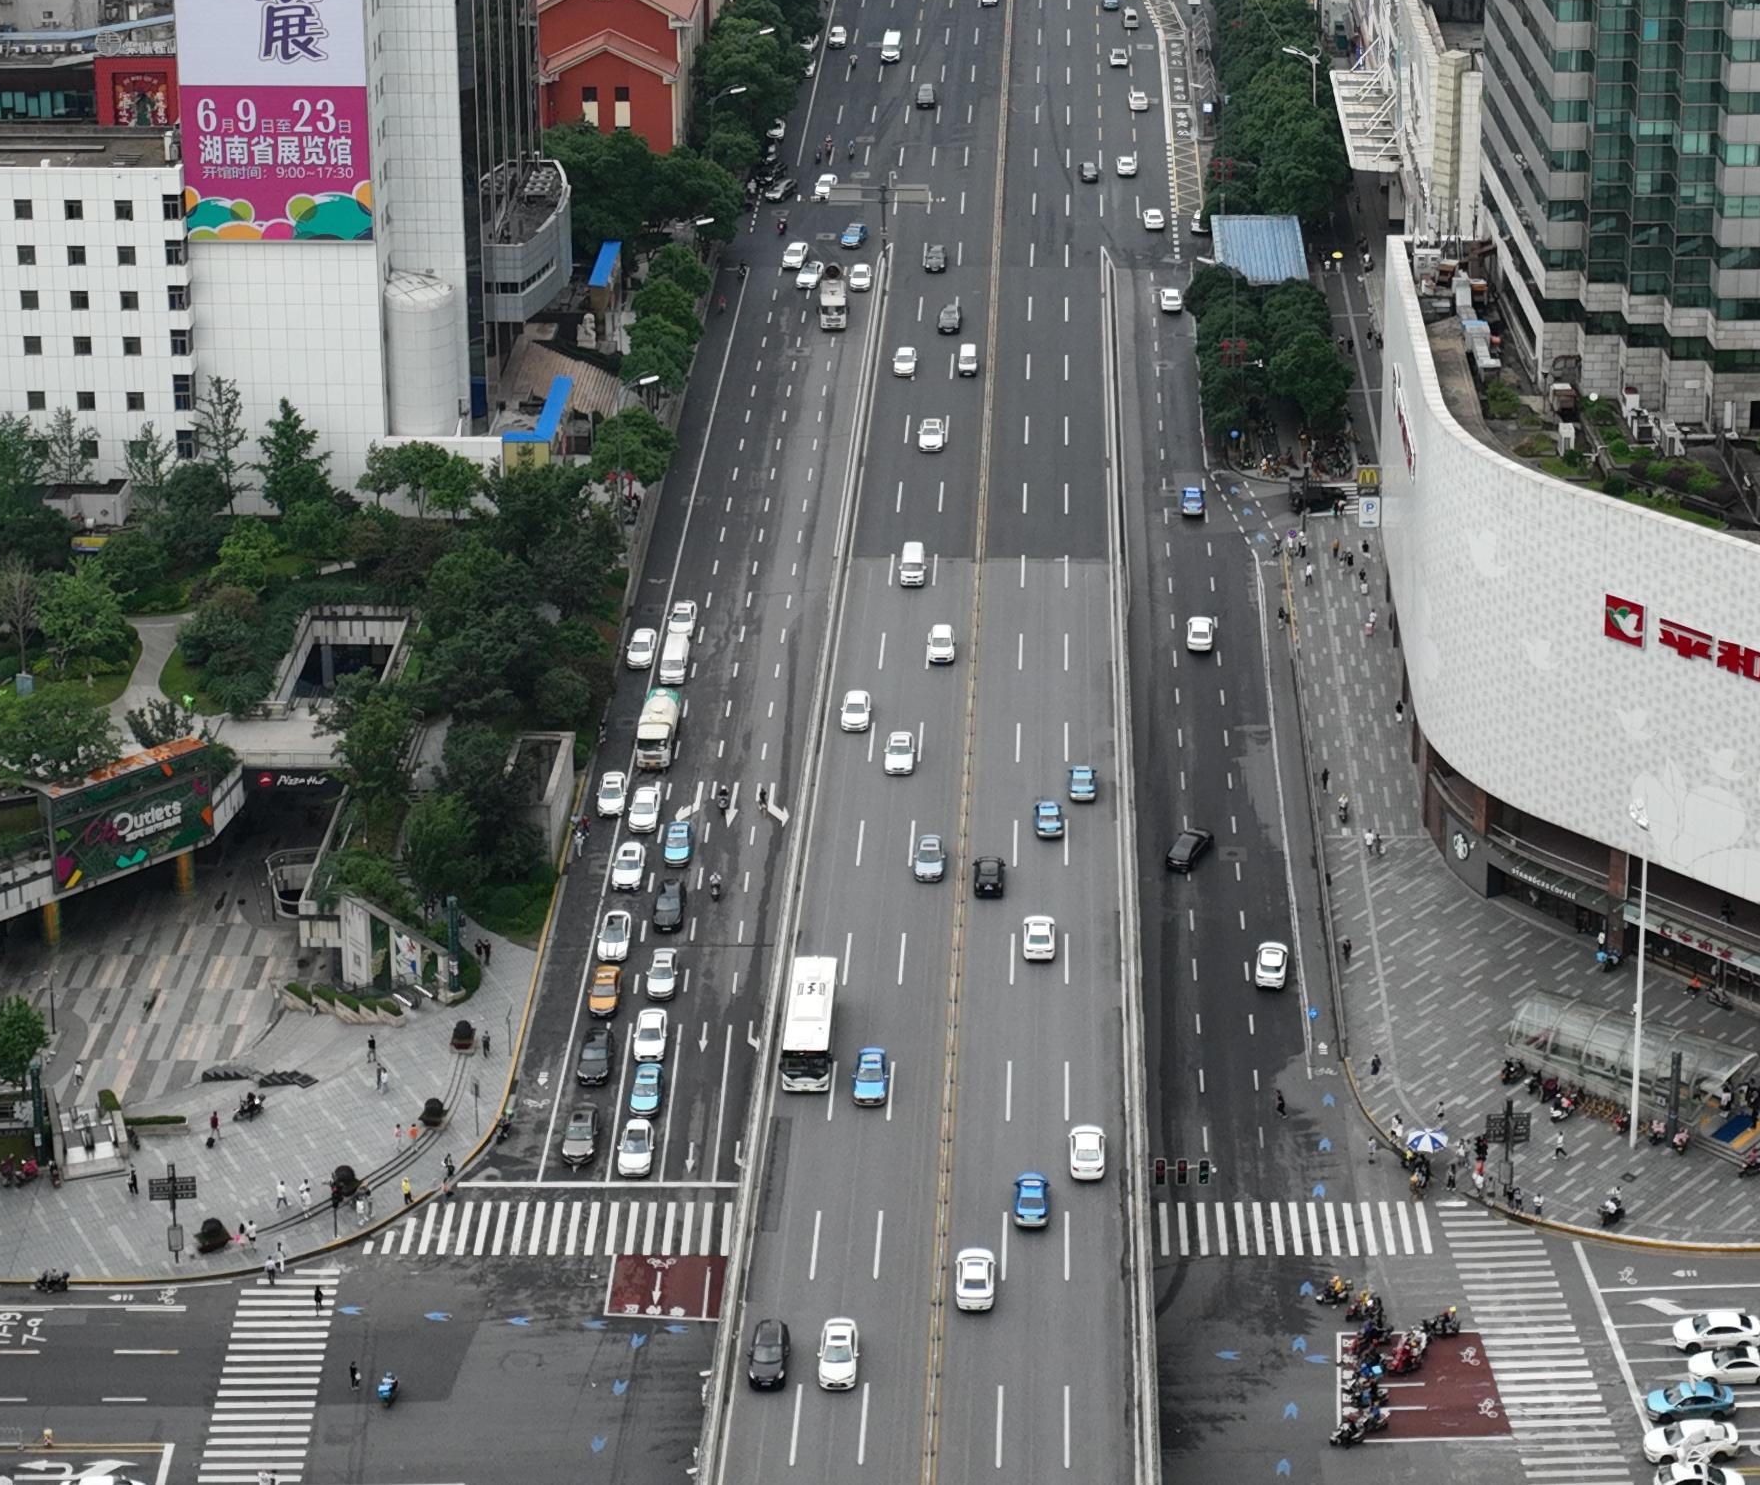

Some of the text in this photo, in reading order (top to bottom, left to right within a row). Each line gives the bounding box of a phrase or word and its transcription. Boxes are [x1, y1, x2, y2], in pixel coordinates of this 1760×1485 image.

[197, 98, 352, 134] 6月9日至23日
[198, 136, 353, 166] 湖南省展览馆
[276, 774, 328, 786] Pizza Hut
[113, 801, 182, 836] Outlets
[21, 1318, 47, 1346] 7-9
